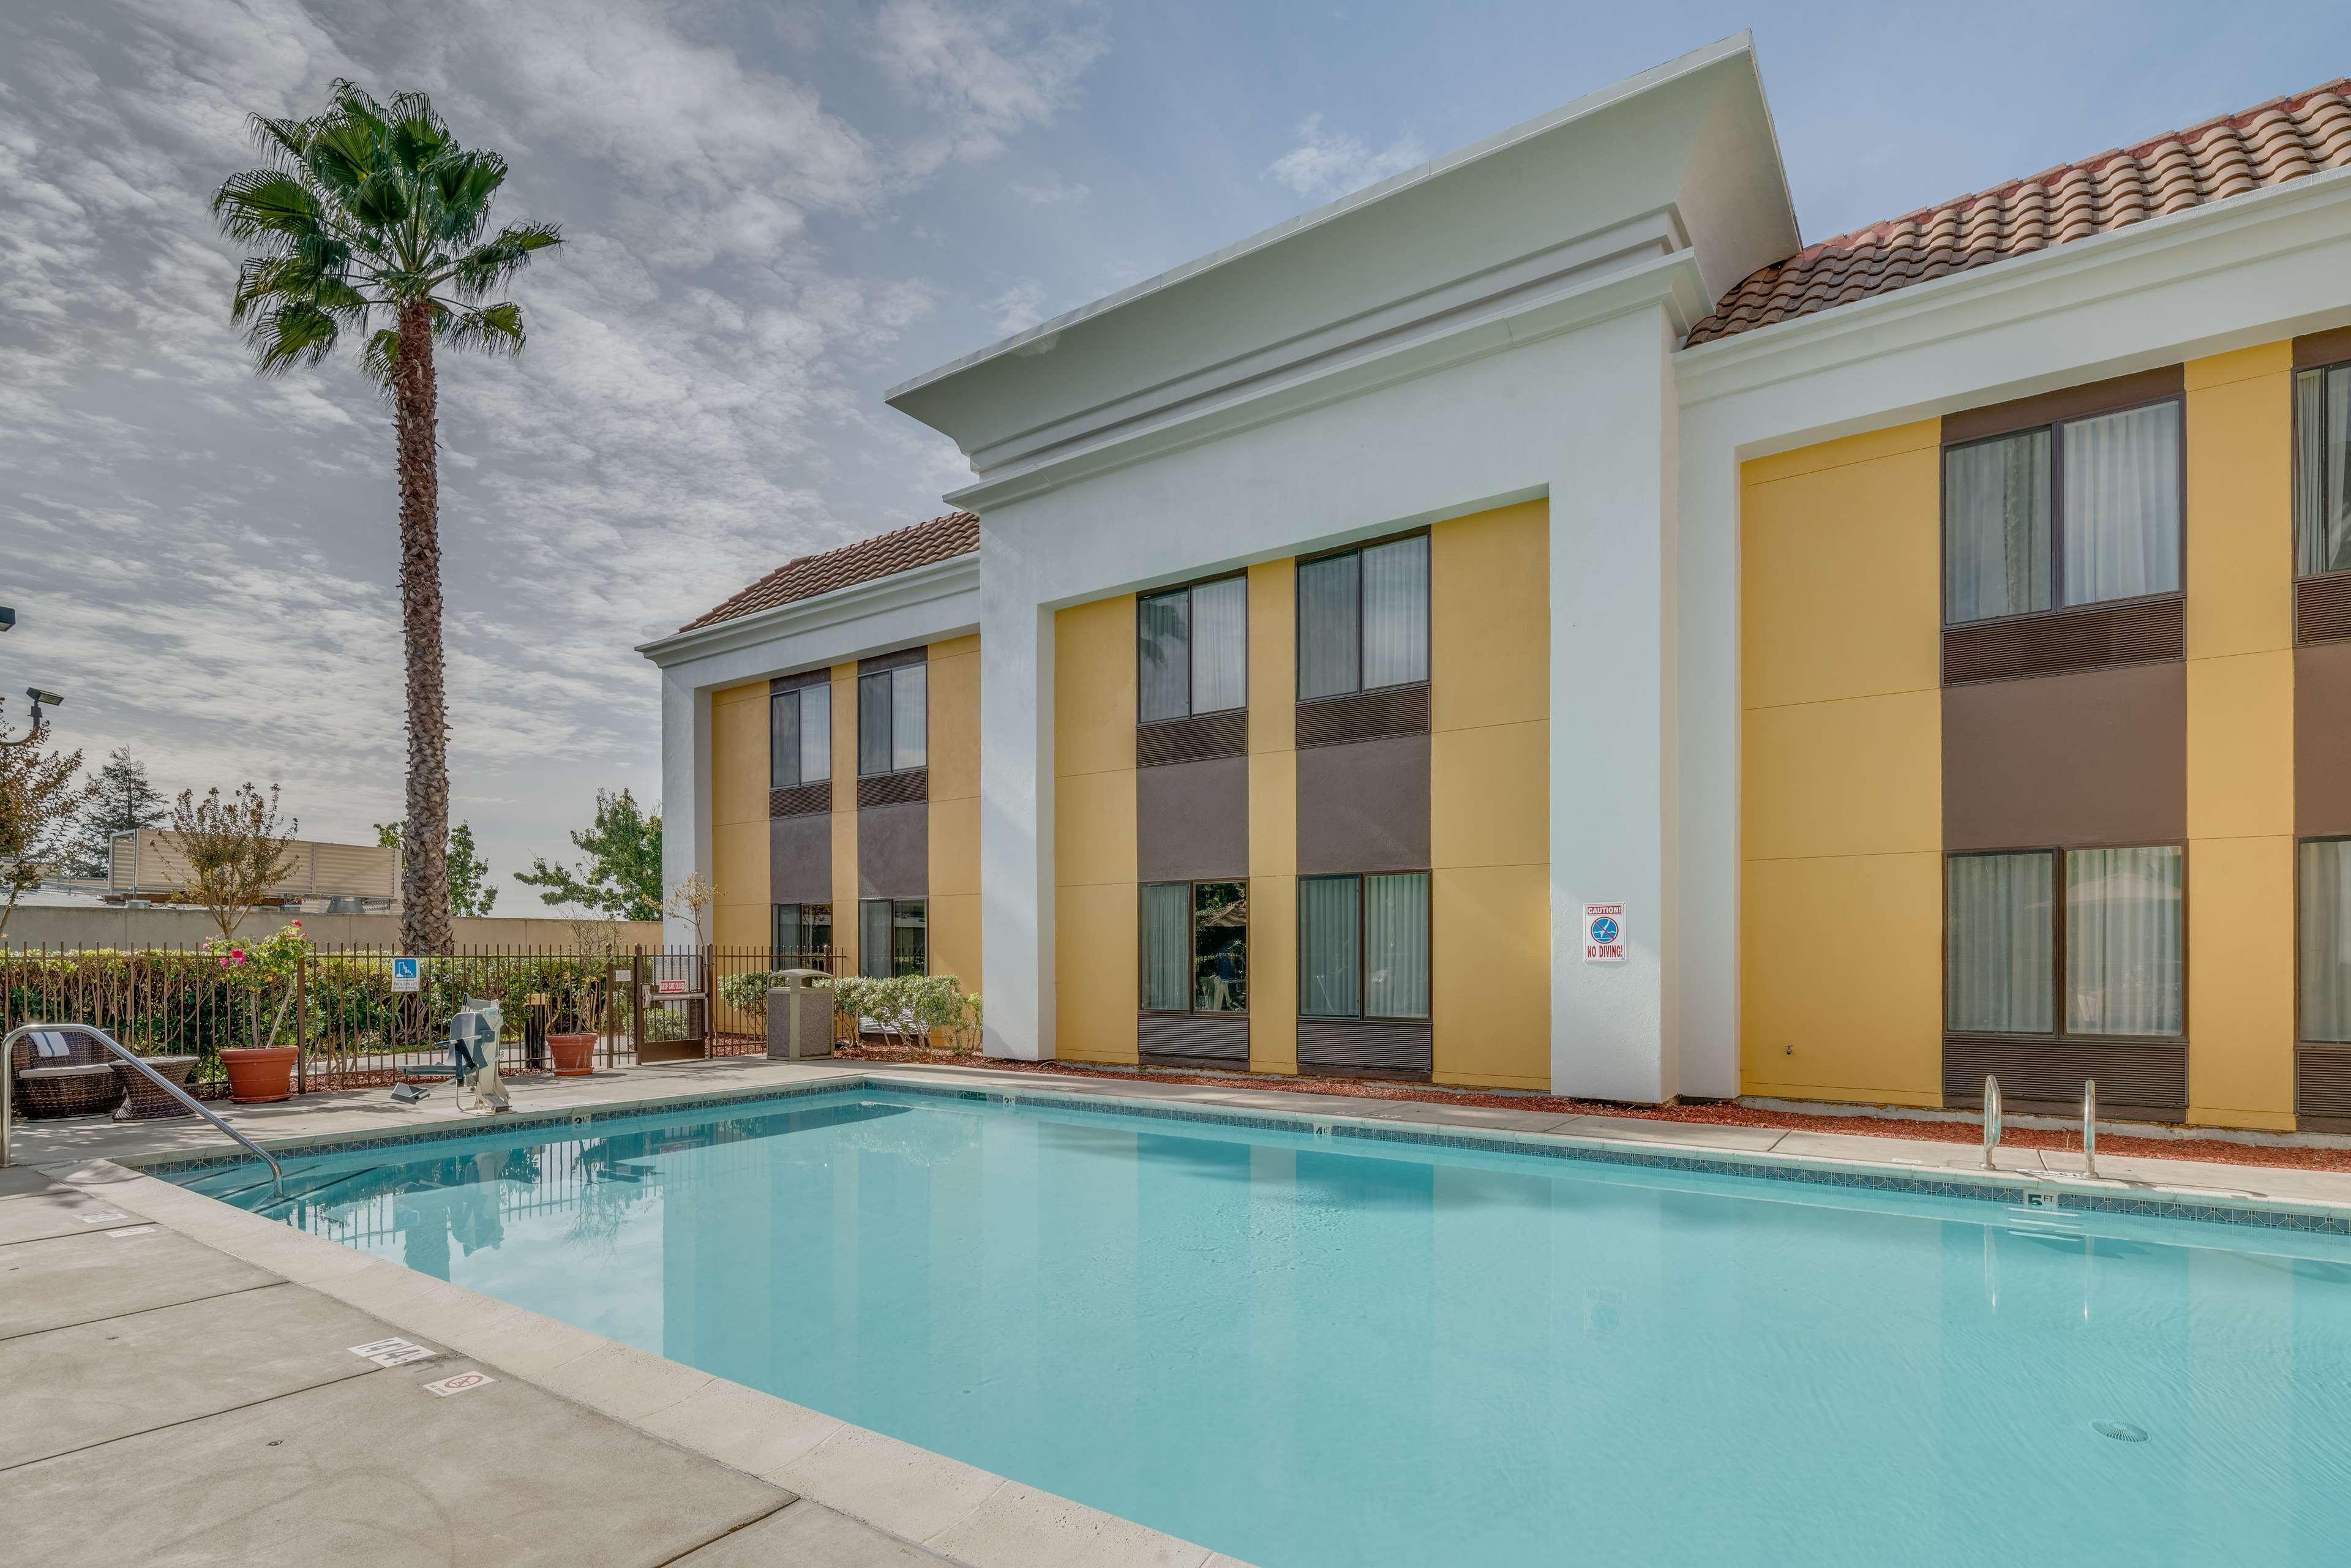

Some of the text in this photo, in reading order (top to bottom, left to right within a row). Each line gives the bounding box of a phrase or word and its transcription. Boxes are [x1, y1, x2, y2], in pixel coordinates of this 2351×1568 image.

[1587, 945, 1622, 958] NO DIVING!
[2028, 1193, 2042, 1206] 5
